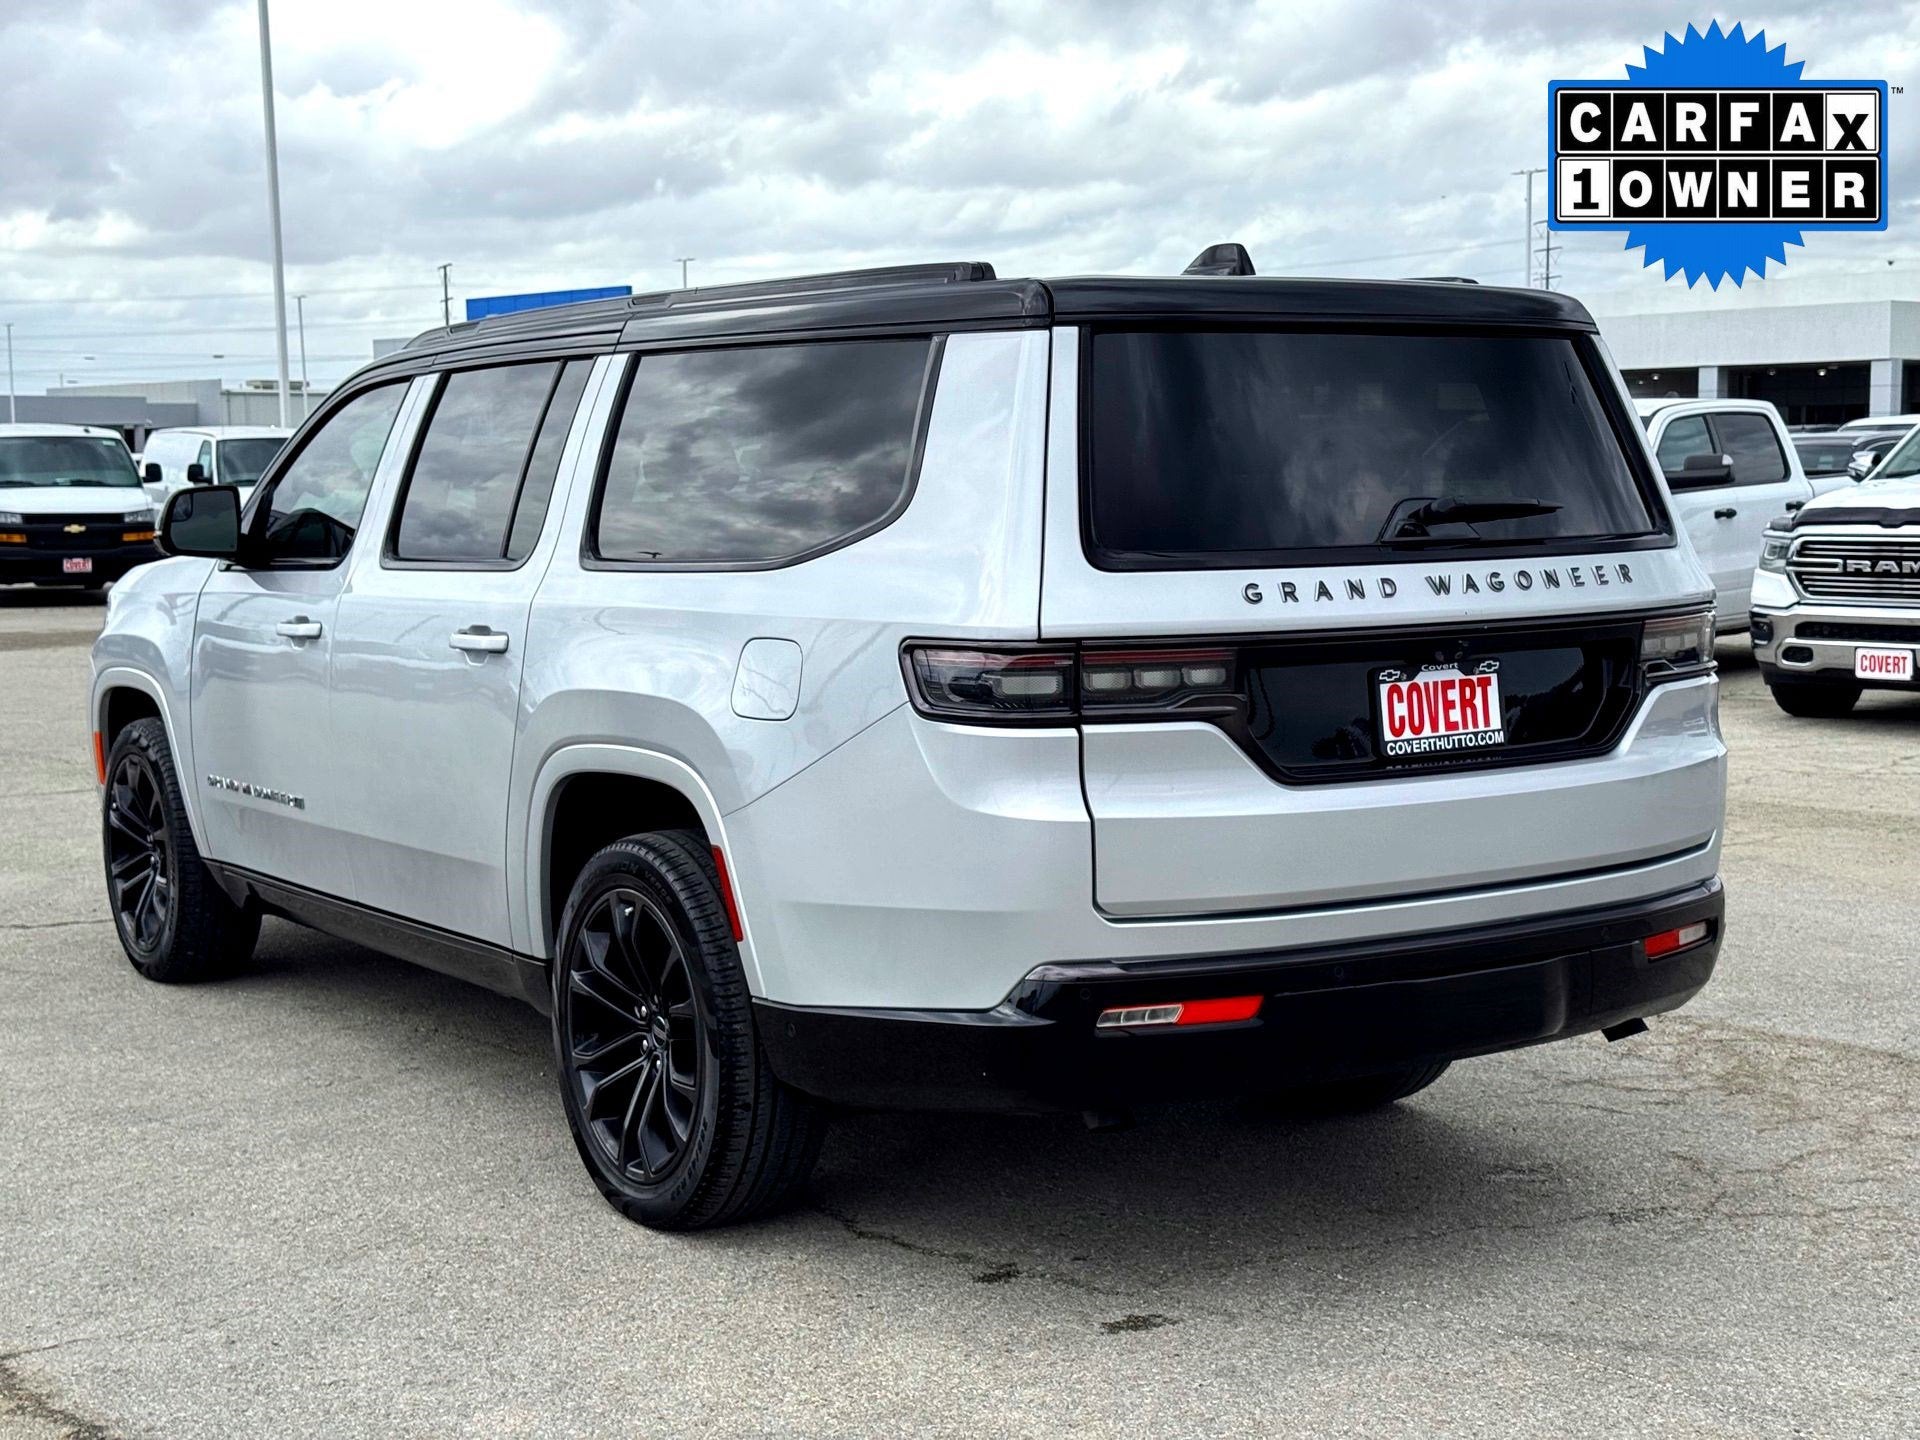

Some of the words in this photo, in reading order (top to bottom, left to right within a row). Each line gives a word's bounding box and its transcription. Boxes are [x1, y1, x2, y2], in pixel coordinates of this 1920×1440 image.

[1241, 576, 1398, 605] GRAND
[1424, 563, 1634, 596] WAGONEER
[1421, 662, 1459, 672] Covert
[1860, 654, 1908, 674] COVERT
[1387, 676, 1492, 738] COVERT
[1386, 731, 1505, 756] COVERTHUTTO.COM
